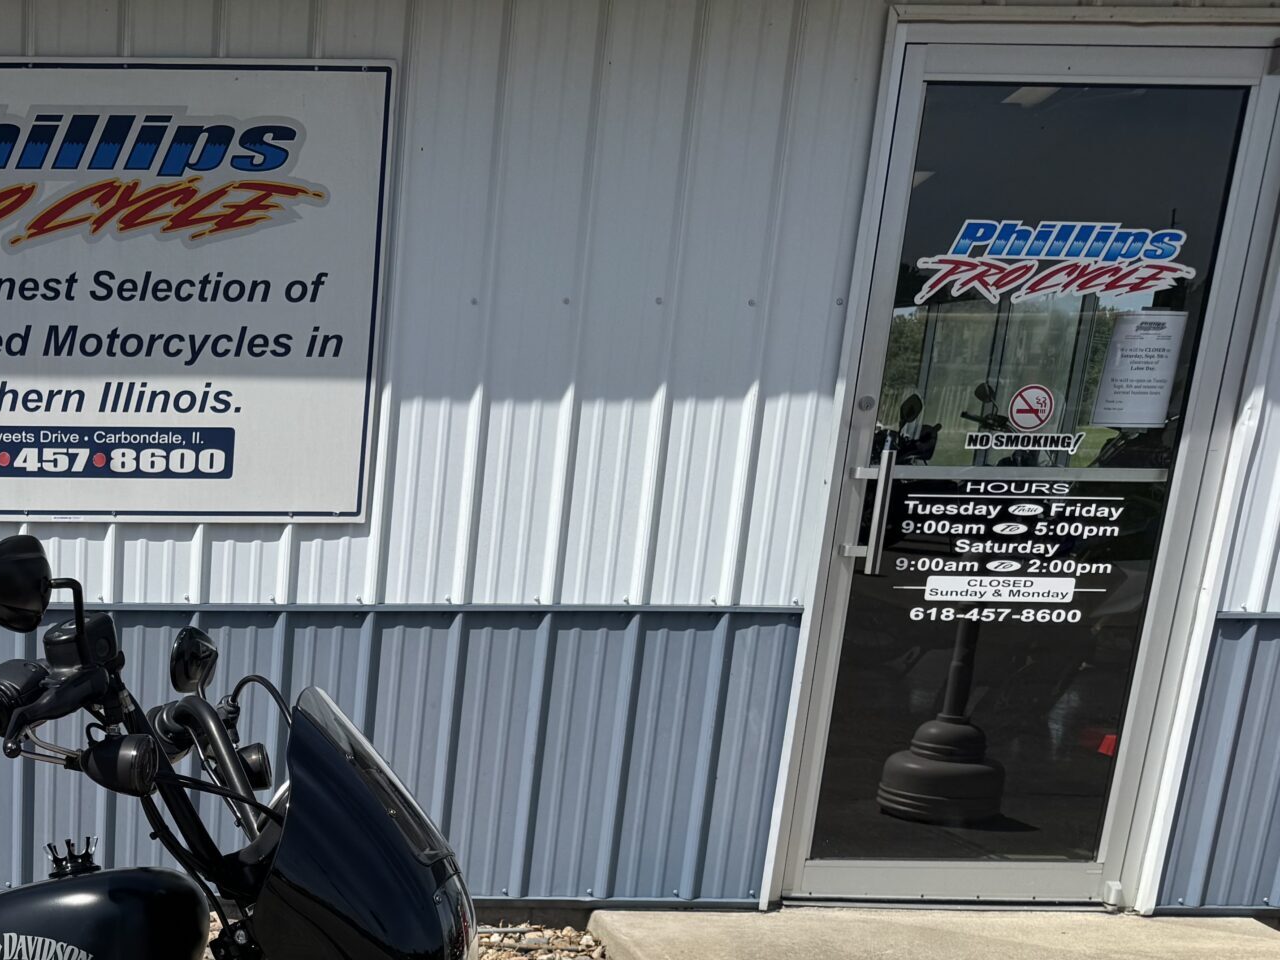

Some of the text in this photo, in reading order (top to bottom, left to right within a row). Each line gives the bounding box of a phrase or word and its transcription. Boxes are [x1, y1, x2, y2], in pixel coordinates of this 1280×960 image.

[9, 175, 327, 245] CYCLE
[951, 221, 1182, 262] Phillips
[89, 270, 272, 303] Selection
[284, 271, 329, 304] of
[918, 258, 1193, 303] PRO CYCLE
[42, 325, 294, 366] Motorcycles
[306, 326, 345, 359] in
[97, 381, 243, 414] Illinois.
[40, 430, 79, 443] Drive
[93, 431, 186, 445] Carbondale,
[968, 433, 1085, 453] NO SMOKING!
[965, 482, 1070, 495] HOURS
[904, 500, 1002, 518] Tuesday
[1050, 503, 1124, 520] Friday
[901, 520, 986, 535] 9:00am
[1034, 522, 1119, 538] 5:00pm
[954, 539, 1060, 557] Saturday
[895, 558, 979, 572] 9:00am
[1027, 559, 1113, 576] 2:00pm
[967, 578, 1034, 588] CLOSED
[928, 588, 1069, 600] Sunday & Monday
[909, 607, 1082, 623] 618-457-8600
